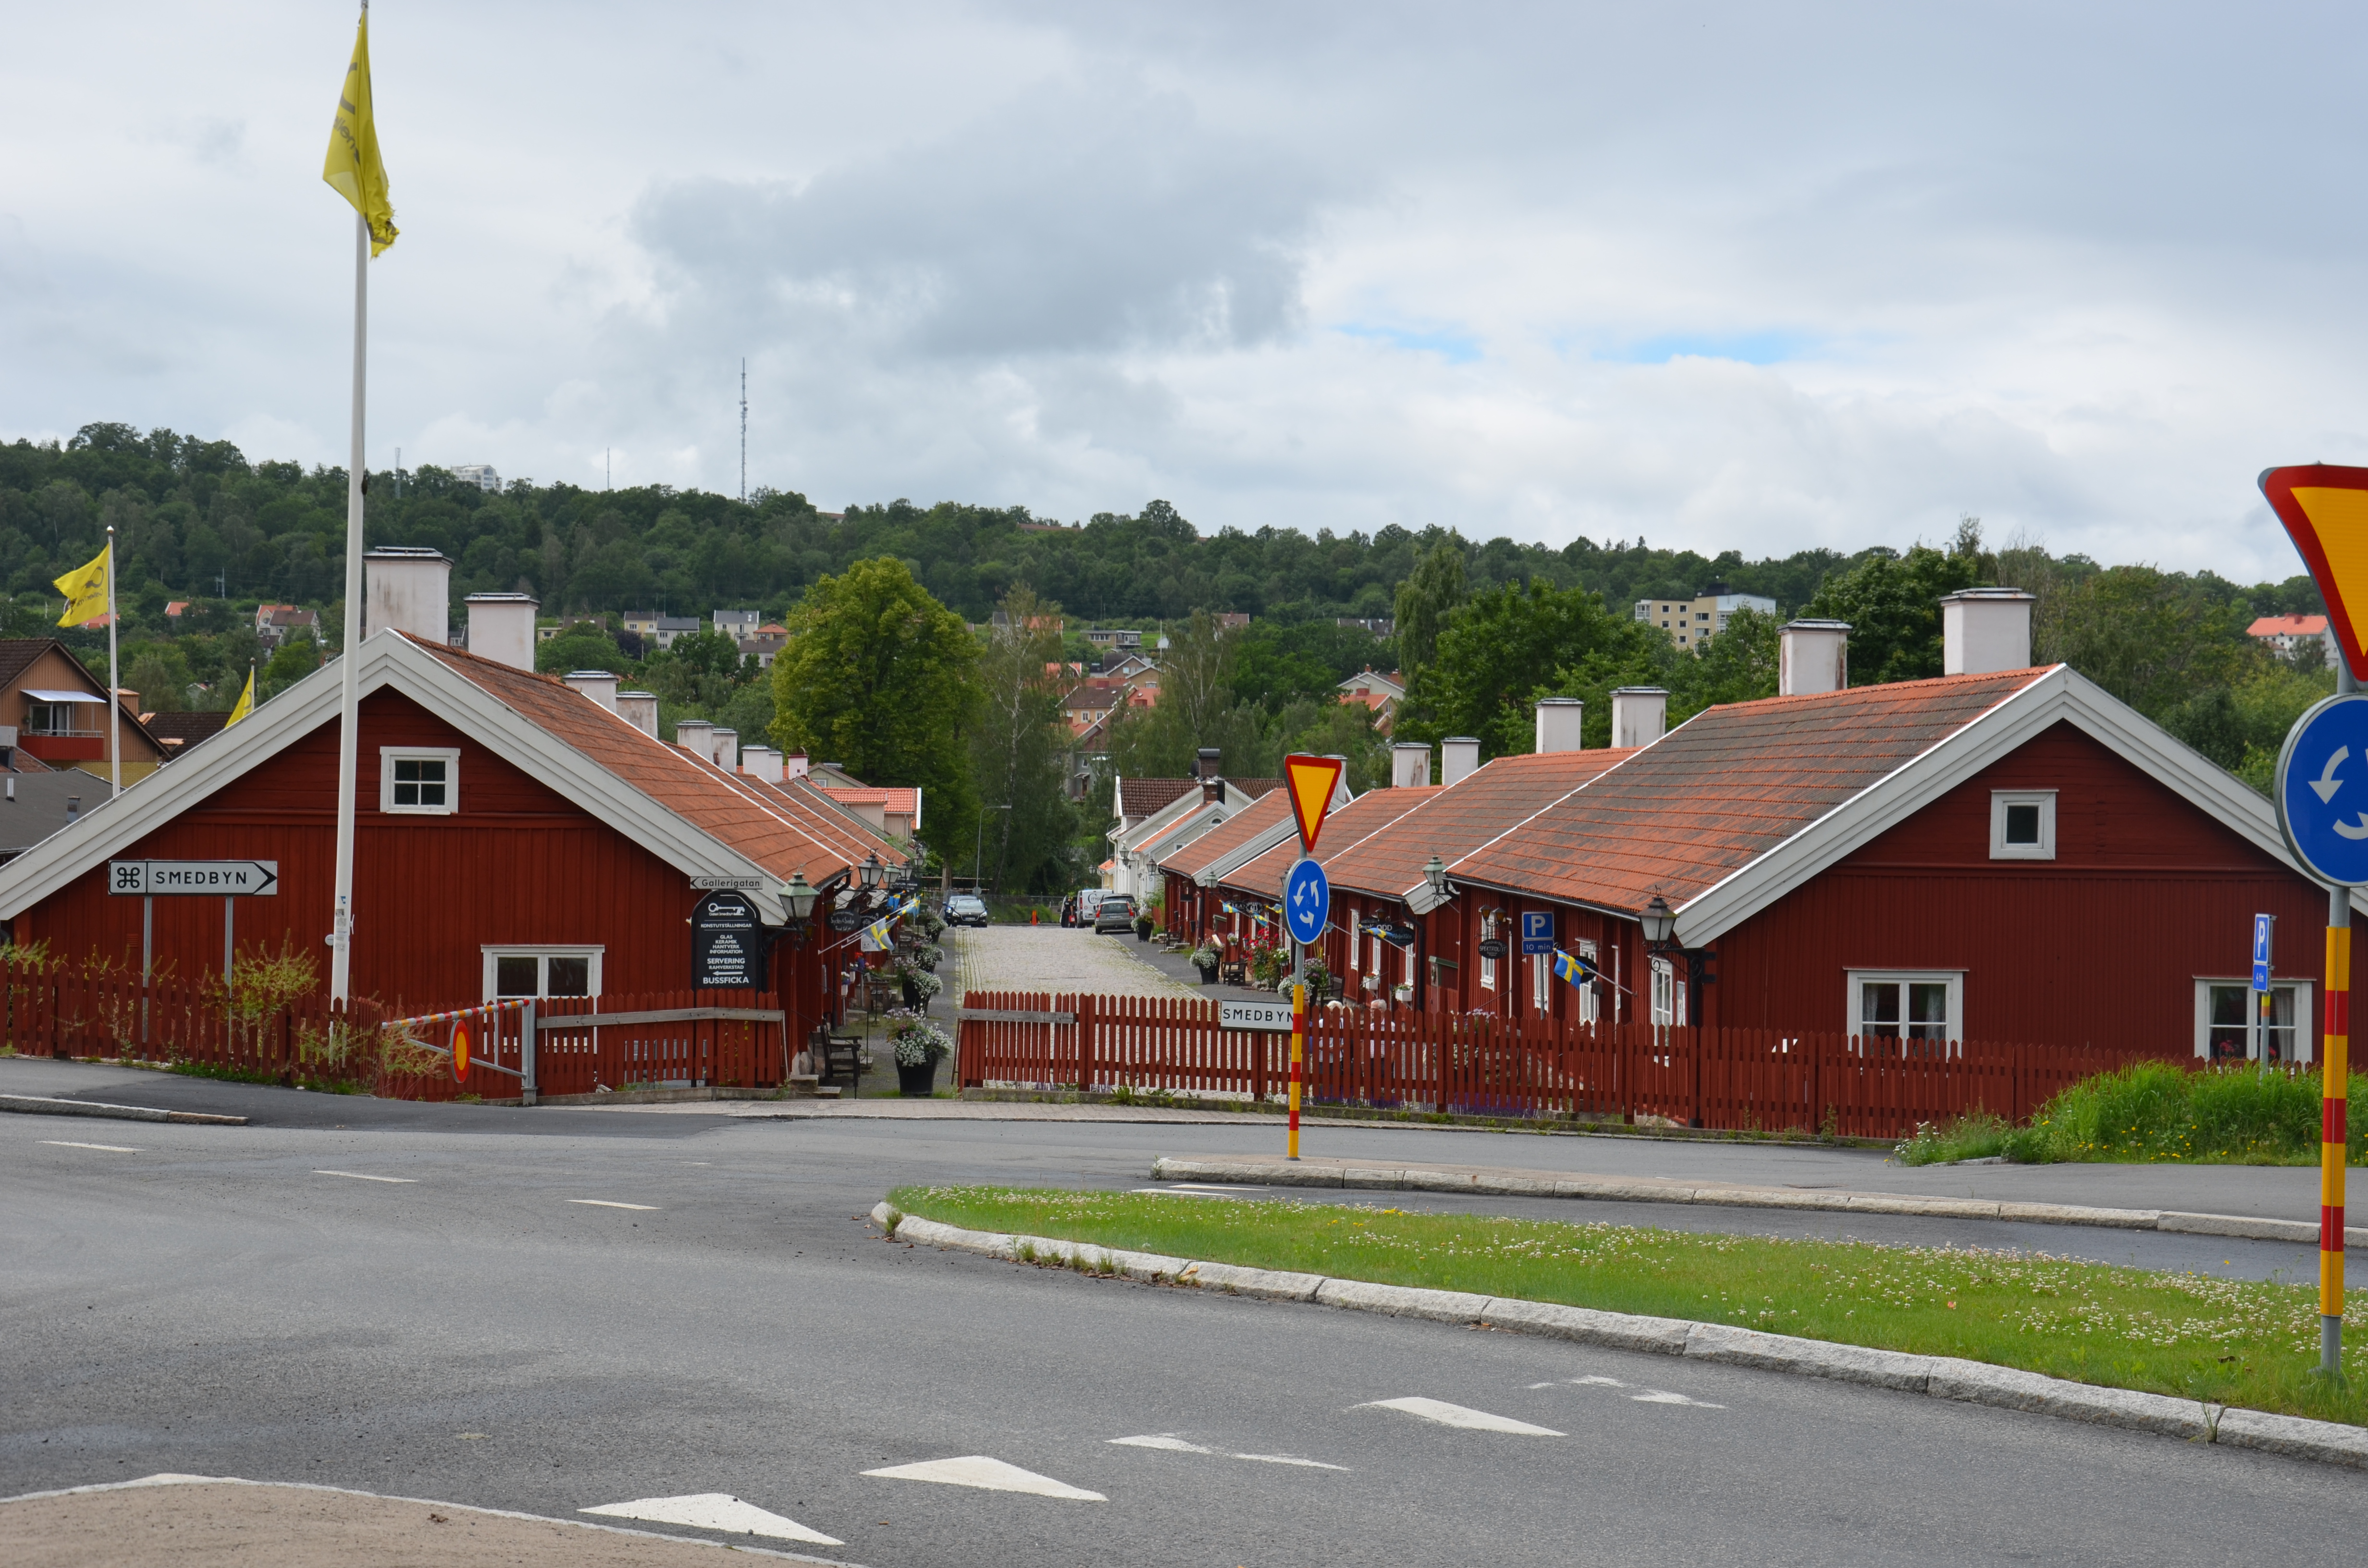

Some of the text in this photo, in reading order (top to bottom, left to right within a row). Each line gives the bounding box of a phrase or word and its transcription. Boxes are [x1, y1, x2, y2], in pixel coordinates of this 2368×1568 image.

[155, 871, 247, 884] SMEDBYN
[702, 879, 760, 888] Gallerigatan
[1531, 915, 1545, 936] P
[2257, 921, 2266, 957] P
[1223, 1008, 1294, 1022] SMEDBYN
